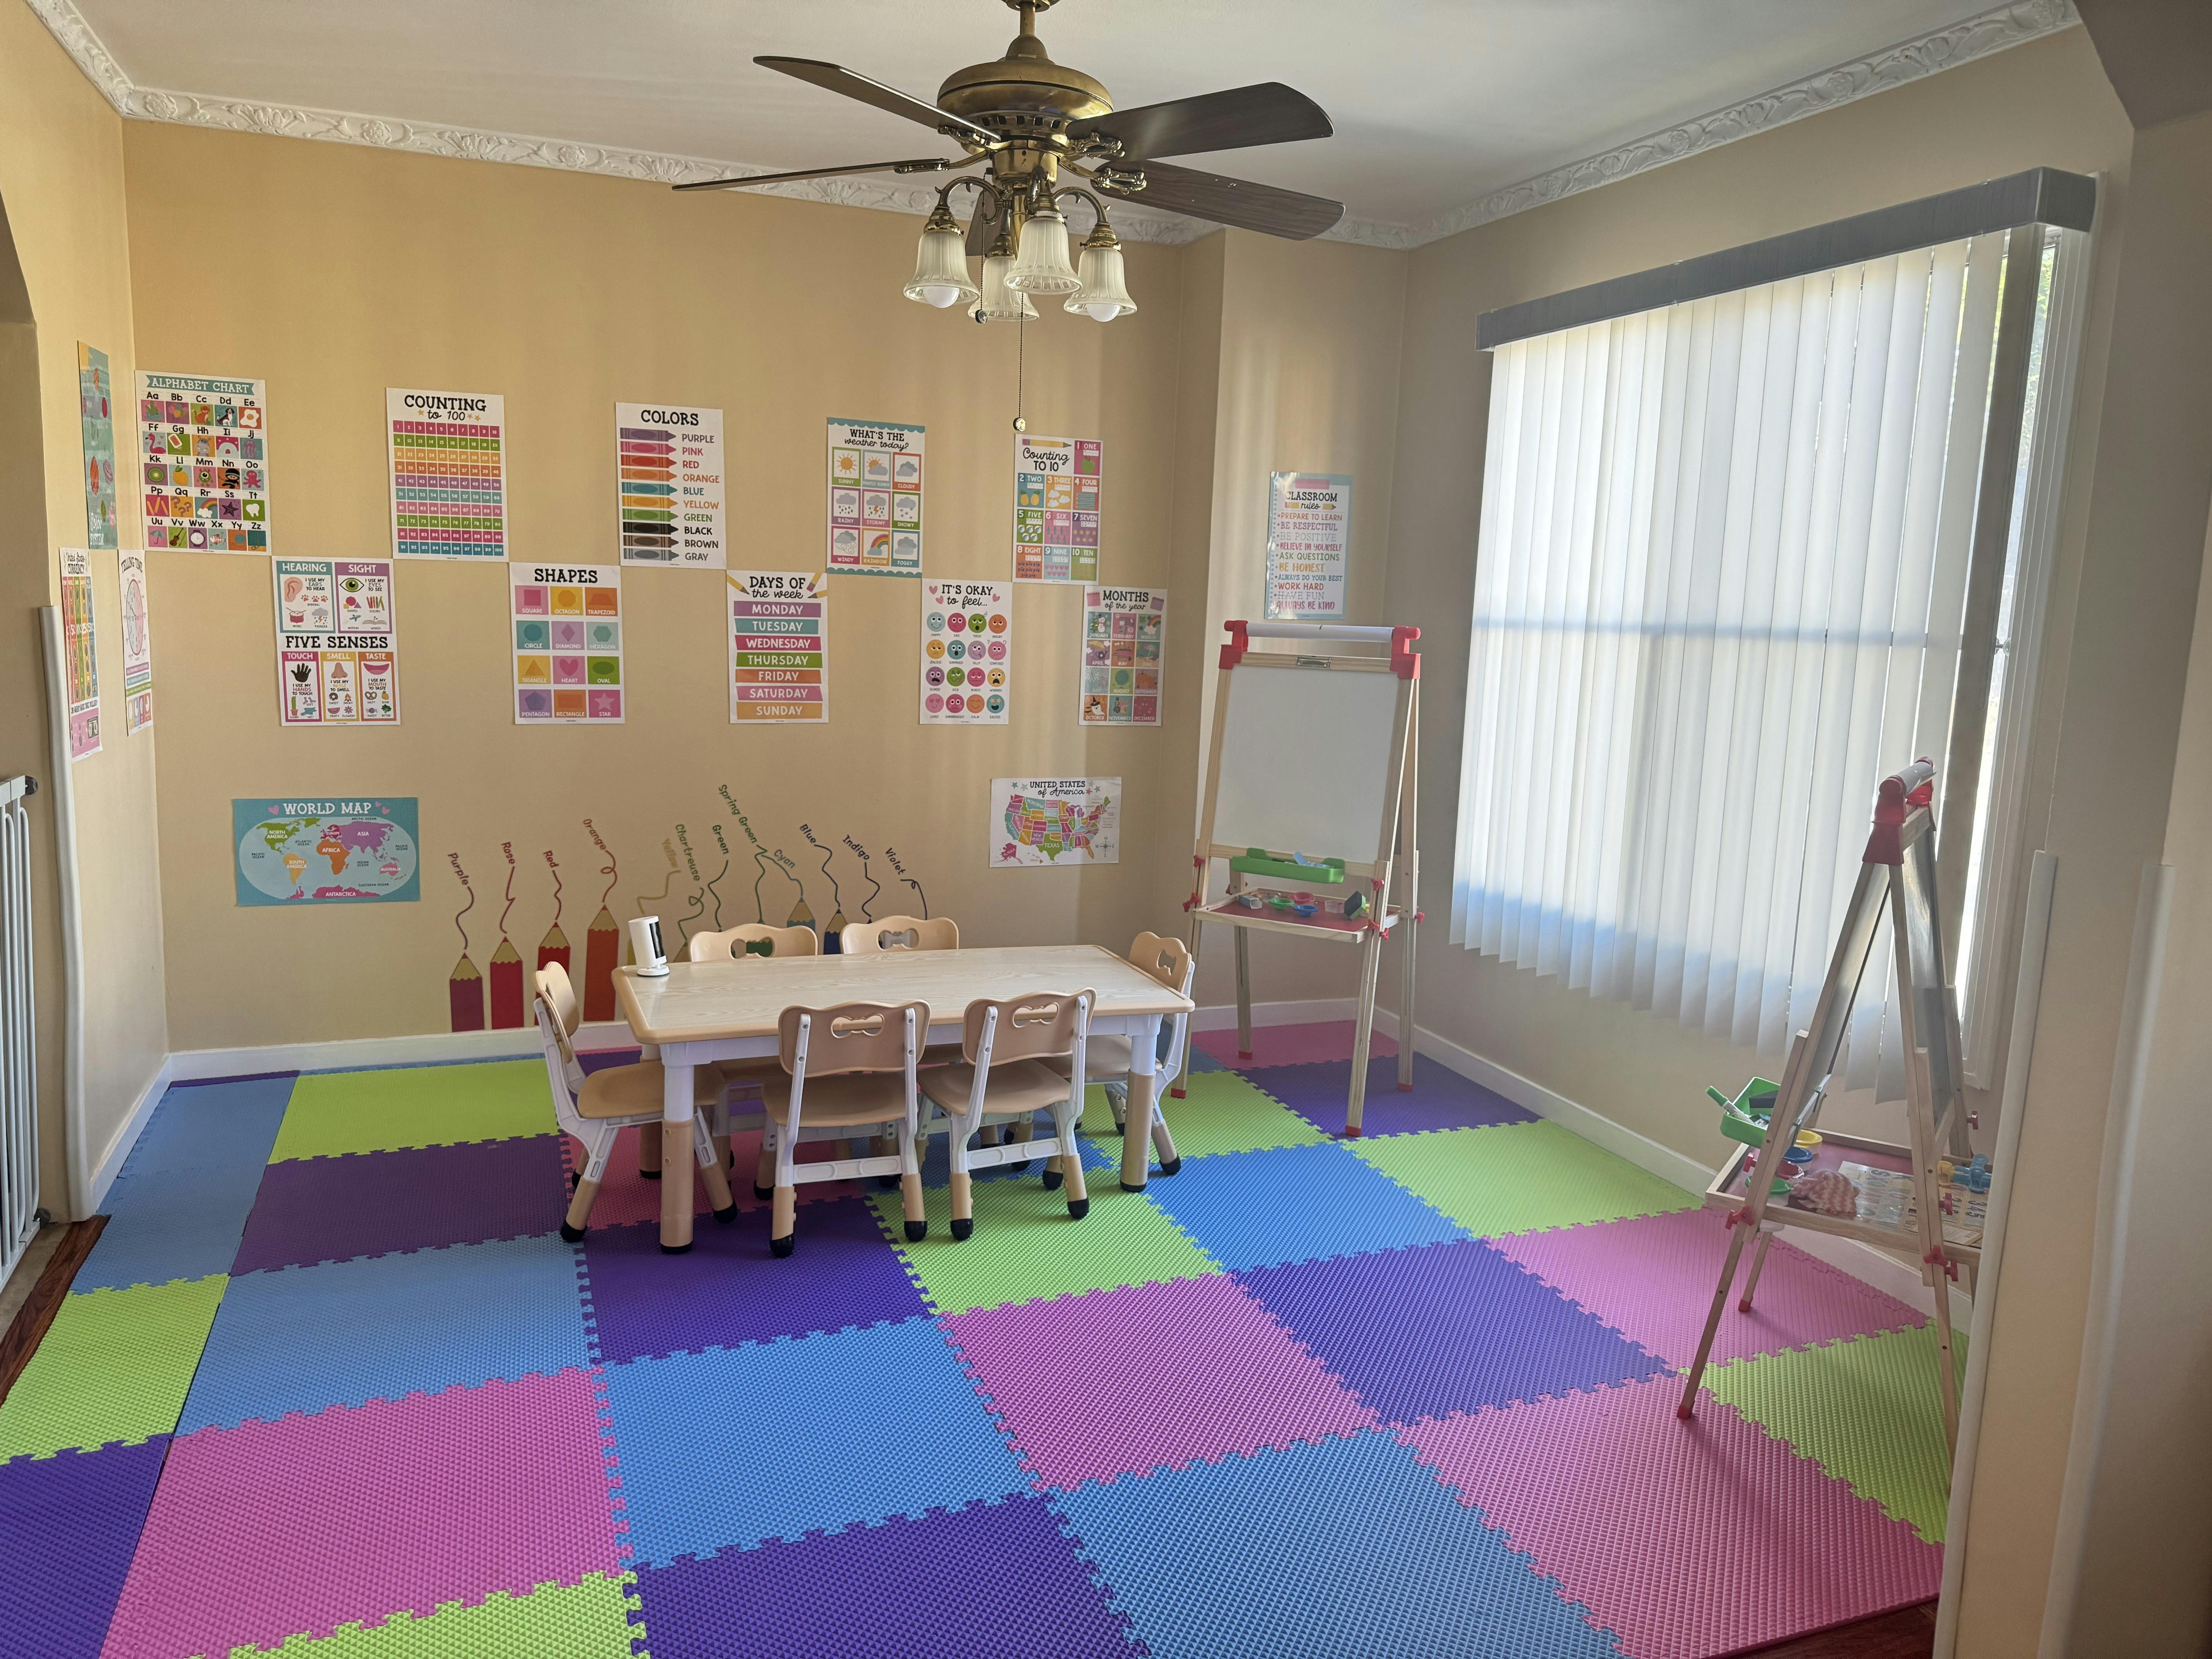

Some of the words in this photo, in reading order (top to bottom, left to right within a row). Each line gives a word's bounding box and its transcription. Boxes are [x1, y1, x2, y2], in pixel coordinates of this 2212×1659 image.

[151, 378, 208, 390] ALPHABET
[213, 383, 249, 393] CHART
[220, 397, 231, 405] Dd
[404, 395, 486, 411] COUNTING
[428, 410, 441, 419] to
[447, 411, 465, 420] 100
[641, 410, 699, 426] COLORS
[682, 434, 714, 443] PURPLE
[850, 429, 883, 440] WHAT'S
[887, 433, 904, 441] THE
[682, 447, 703, 456] PINK
[881, 441, 909, 452] today?
[1023, 447, 1069, 465] Counting
[682, 460, 699, 469] RED
[1034, 461, 1046, 471] TO
[1050, 462, 1059, 472] 10
[683, 474, 720, 483] ORANGE
[684, 487, 704, 495] BLUE
[1285, 491, 1338, 501] CLASSROOM
[684, 500, 719, 509] YELLOW
[684, 514, 712, 522] GREEN
[684, 527, 712, 535] BLACK
[1293, 522, 1337, 531] RESPECTFUL
[1295, 533, 1336, 541] POSITIVE
[685, 540, 718, 548] BROWN
[685, 553, 708, 561] GRAY
[1297, 553, 1339, 561] QUESTIONS
[282, 563, 326, 572] HEARING
[349, 564, 376, 573] SIGHT
[1279, 563, 1289, 572] BE
[1293, 563, 1324, 572] HONEST
[534, 568, 598, 583] SHAPES
[749, 577, 783, 588] DAYS
[789, 577, 805, 589] OF
[752, 589, 769, 598] the
[774, 590, 804, 599] week
[942, 584, 962, 594] IT'S
[966, 586, 993, 596] OKAY
[947, 596, 958, 605] to
[1103, 590, 1149, 603] MONTHS
[752, 605, 803, 615] MONDAY
[1105, 603, 1114, 611] of
[752, 621, 803, 631] TUESDAY
[286, 636, 320, 648] FIVE
[328, 636, 388, 648] SENSES
[746, 639, 811, 648] WEDNESDAY
[748, 655, 809, 665] THURSDAY
[759, 672, 799, 681] FRIDAY
[750, 689, 808, 698] SATURDAY
[756, 706, 802, 715] SUNDAY
[1038, 788, 1047, 798] of
[1050, 787, 1085, 796] America
[283, 803, 335, 815] WORLD
[341, 802, 372, 814] MAP
[718, 784, 740, 816] Spring
[739, 817, 757, 843] Green
[583, 818, 606, 850] Orange
[713, 824, 729, 854] Green
[799, 824, 816, 844] Blue
[675, 824, 700, 881] Chartreuse
[842, 835, 870, 860] Indigo
[501, 842, 515, 864] Rose
[661, 838, 678, 868] Yellow
[543, 850, 559, 869] Red
[774, 849, 795, 868] Cyan
[885, 847, 906, 875] Violet
[448, 852, 468, 885] Purple
